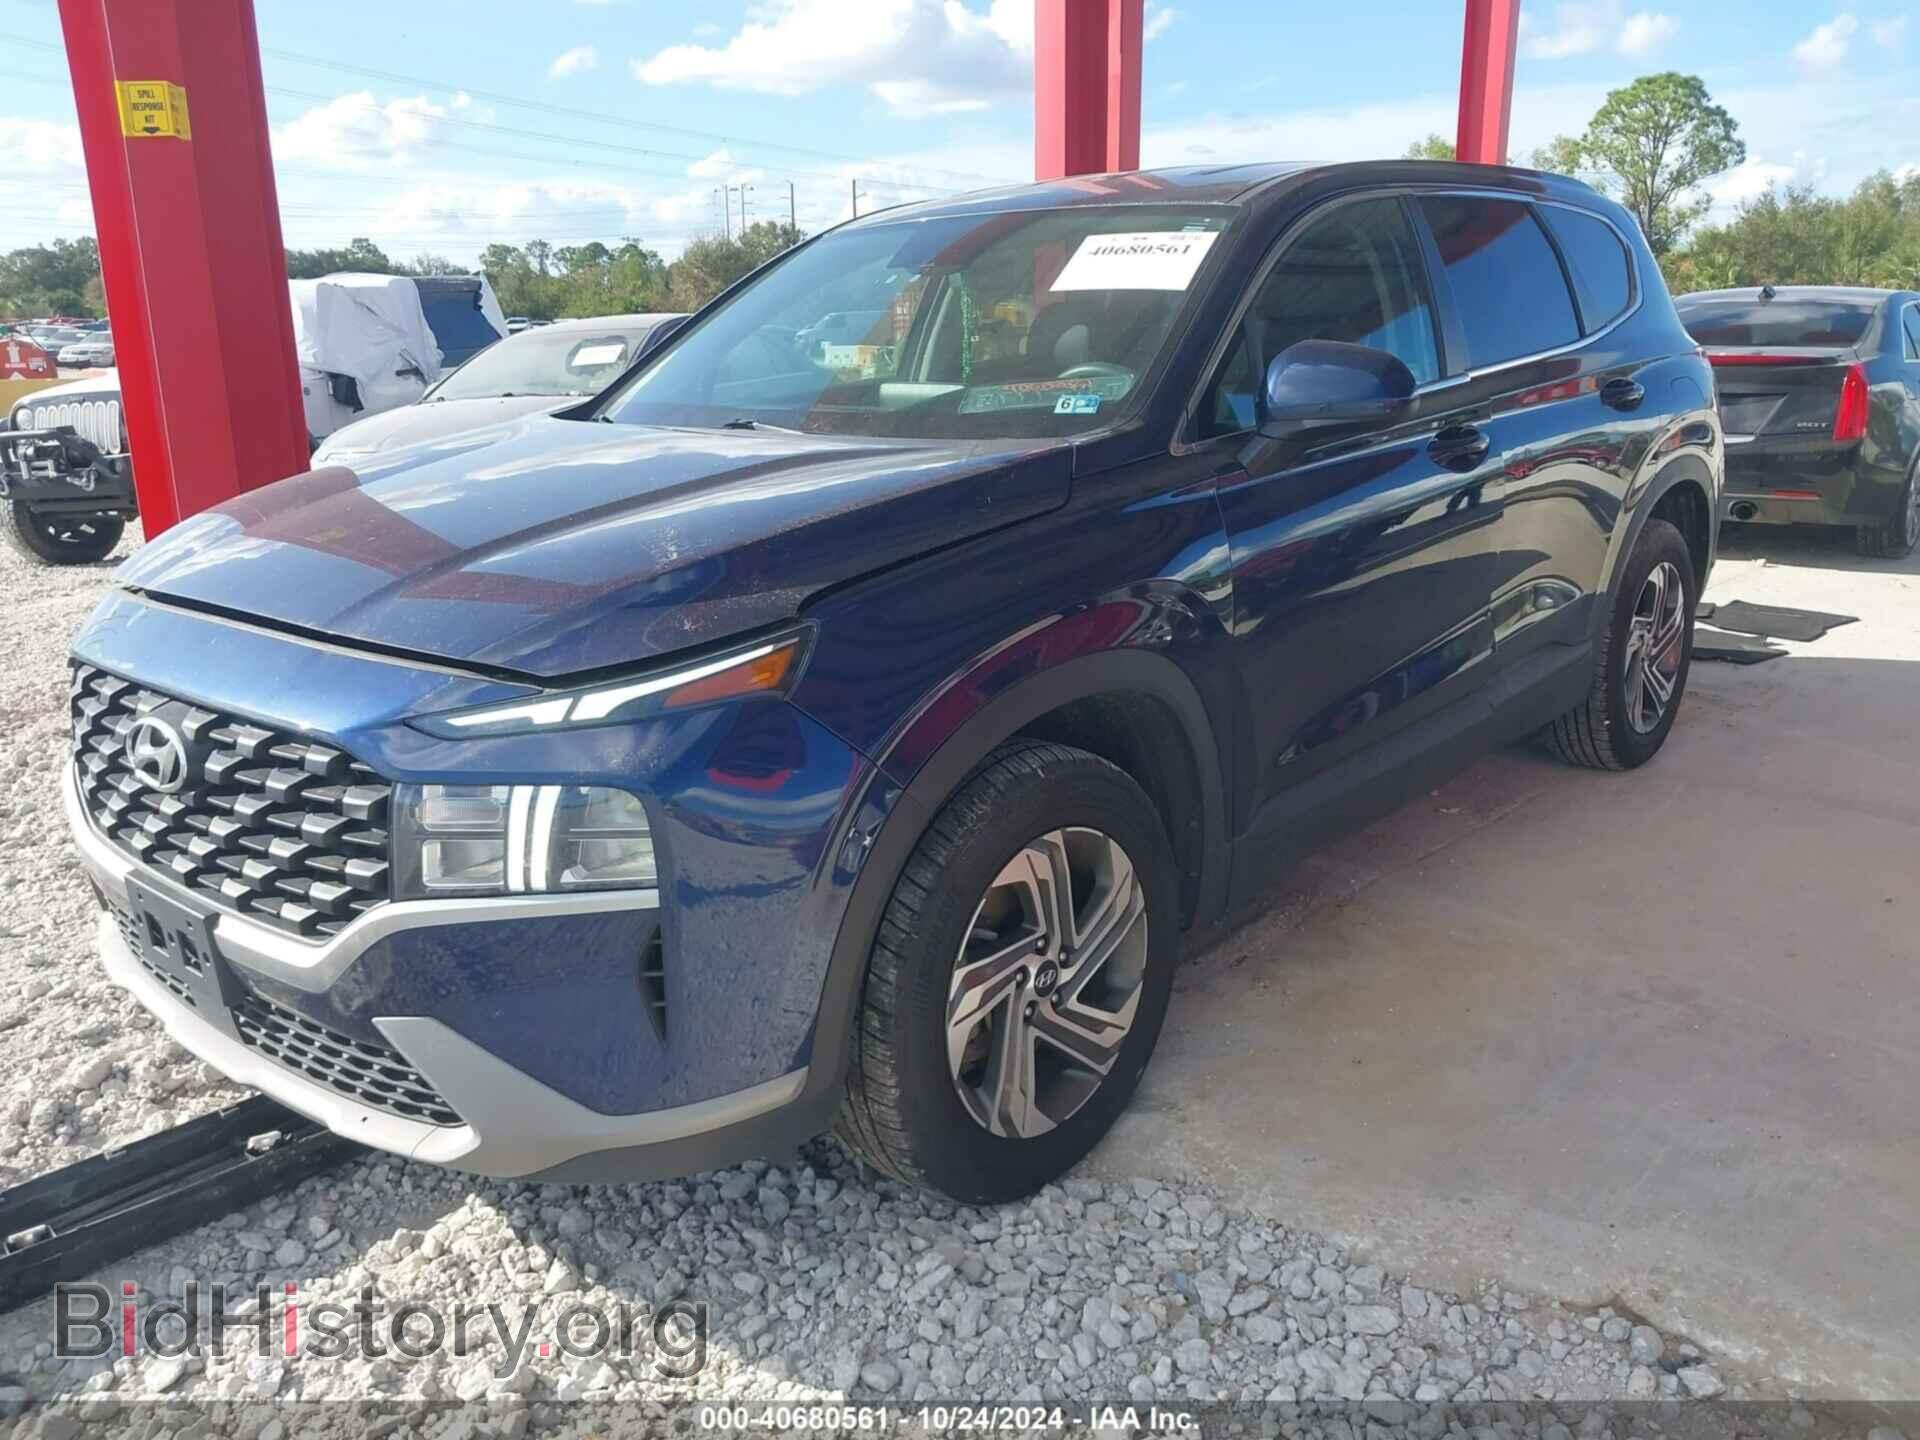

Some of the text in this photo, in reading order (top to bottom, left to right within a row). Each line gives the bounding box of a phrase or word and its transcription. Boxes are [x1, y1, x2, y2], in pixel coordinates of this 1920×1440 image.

[137, 89, 155, 98] SPILL
[131, 102, 166, 111] RESPONSE
[144, 114, 156, 123] KIT
[1088, 243, 1192, 256] 40680561
